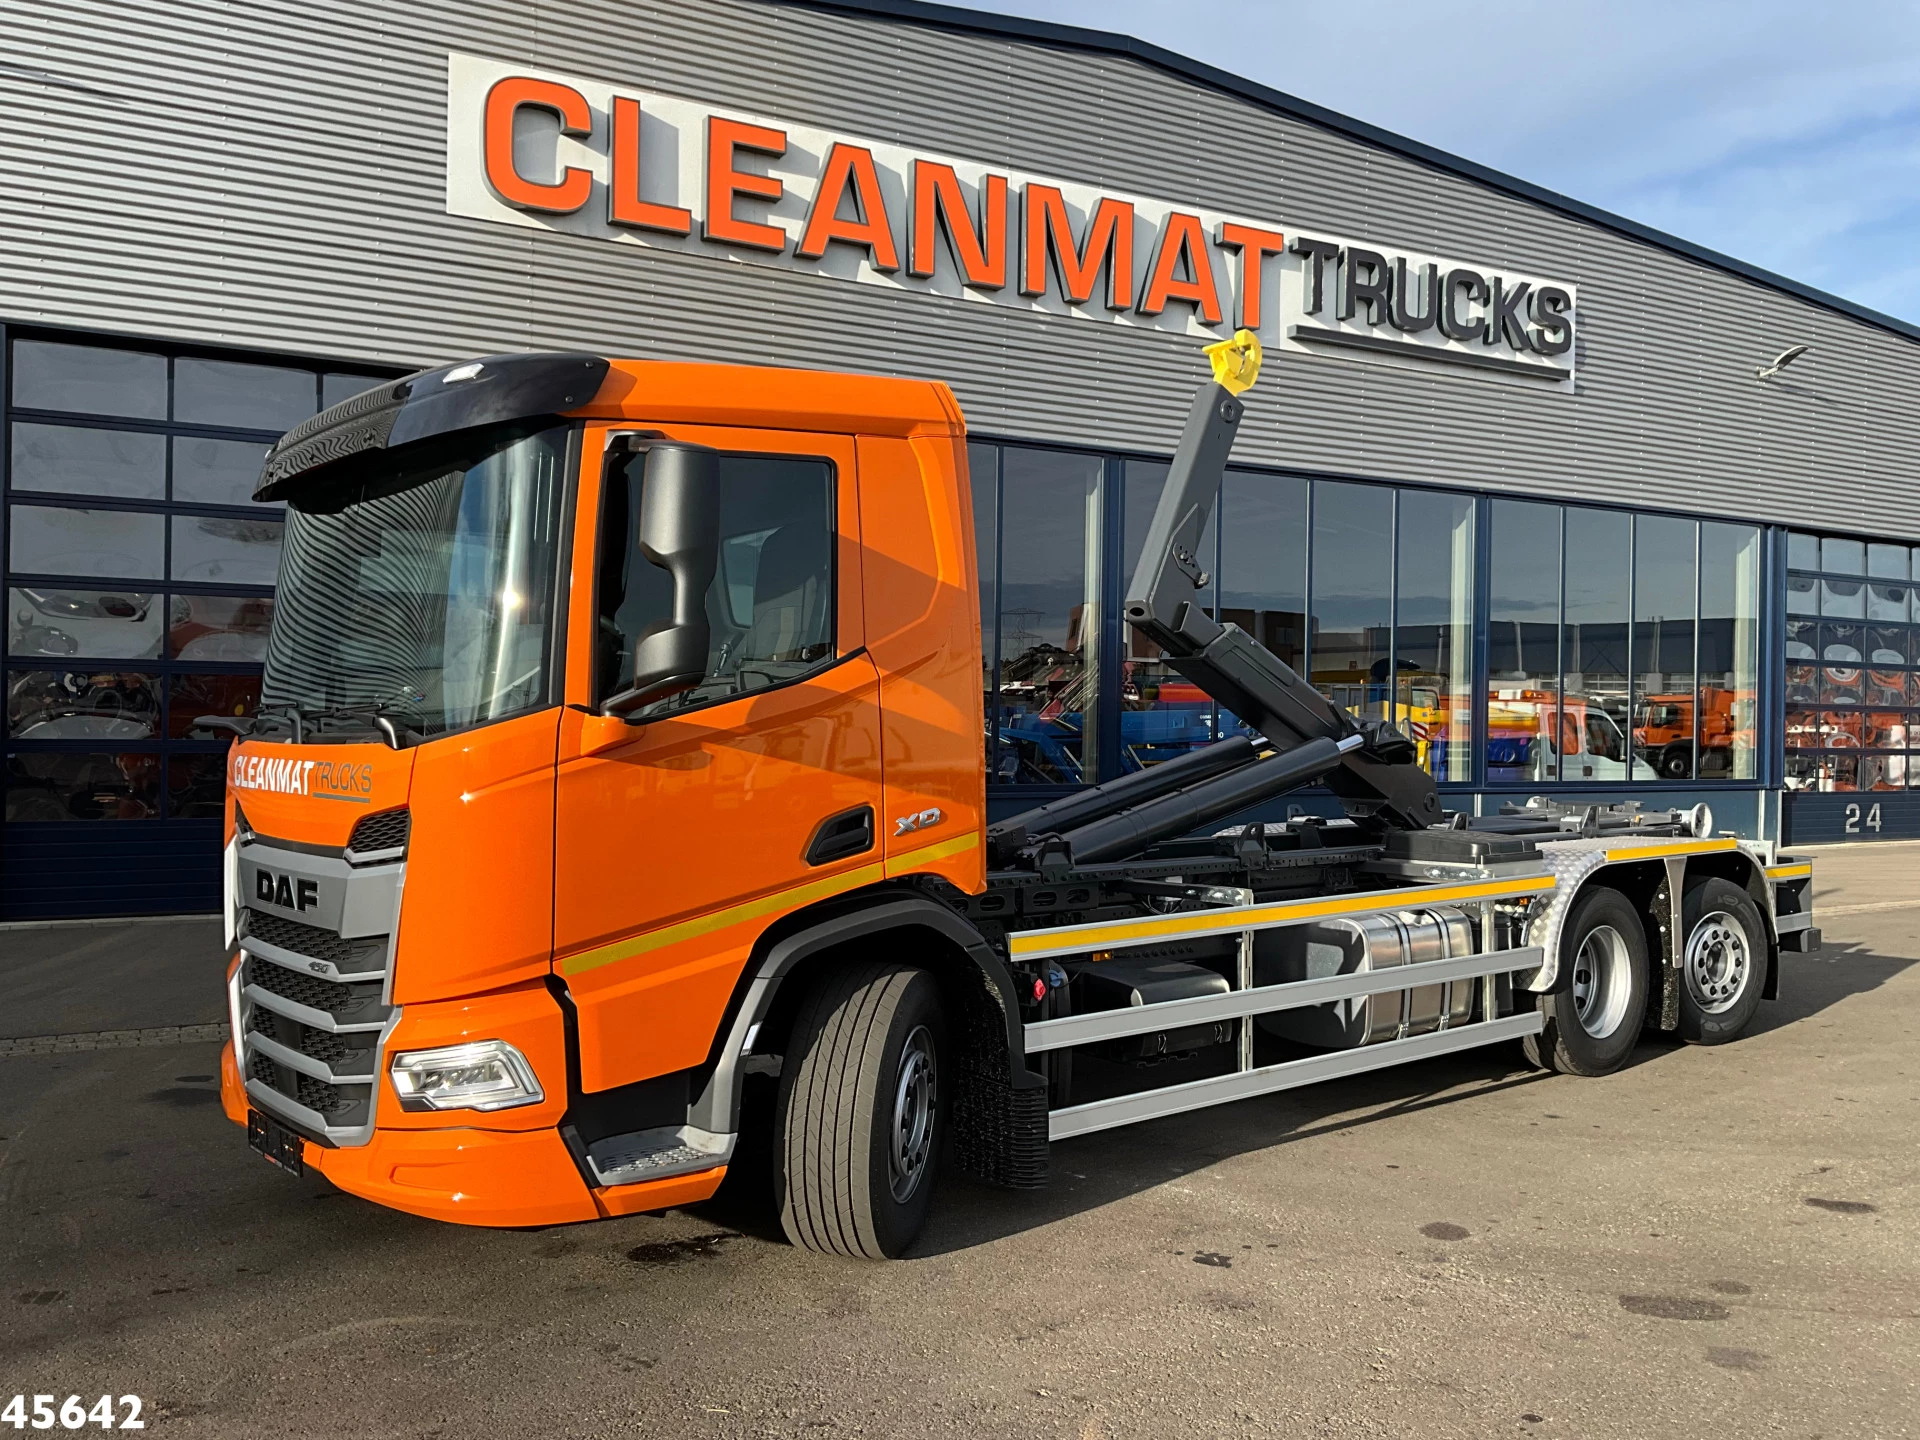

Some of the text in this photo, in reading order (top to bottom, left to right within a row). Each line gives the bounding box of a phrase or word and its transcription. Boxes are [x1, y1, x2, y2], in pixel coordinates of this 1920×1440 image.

[484, 76, 1573, 355] CLEANMAT TRUCKS
[234, 755, 373, 796] CLEANMAT TRUCKS
[893, 807, 940, 836] XD
[1845, 802, 1882, 833] 24
[256, 867, 320, 913] DAF
